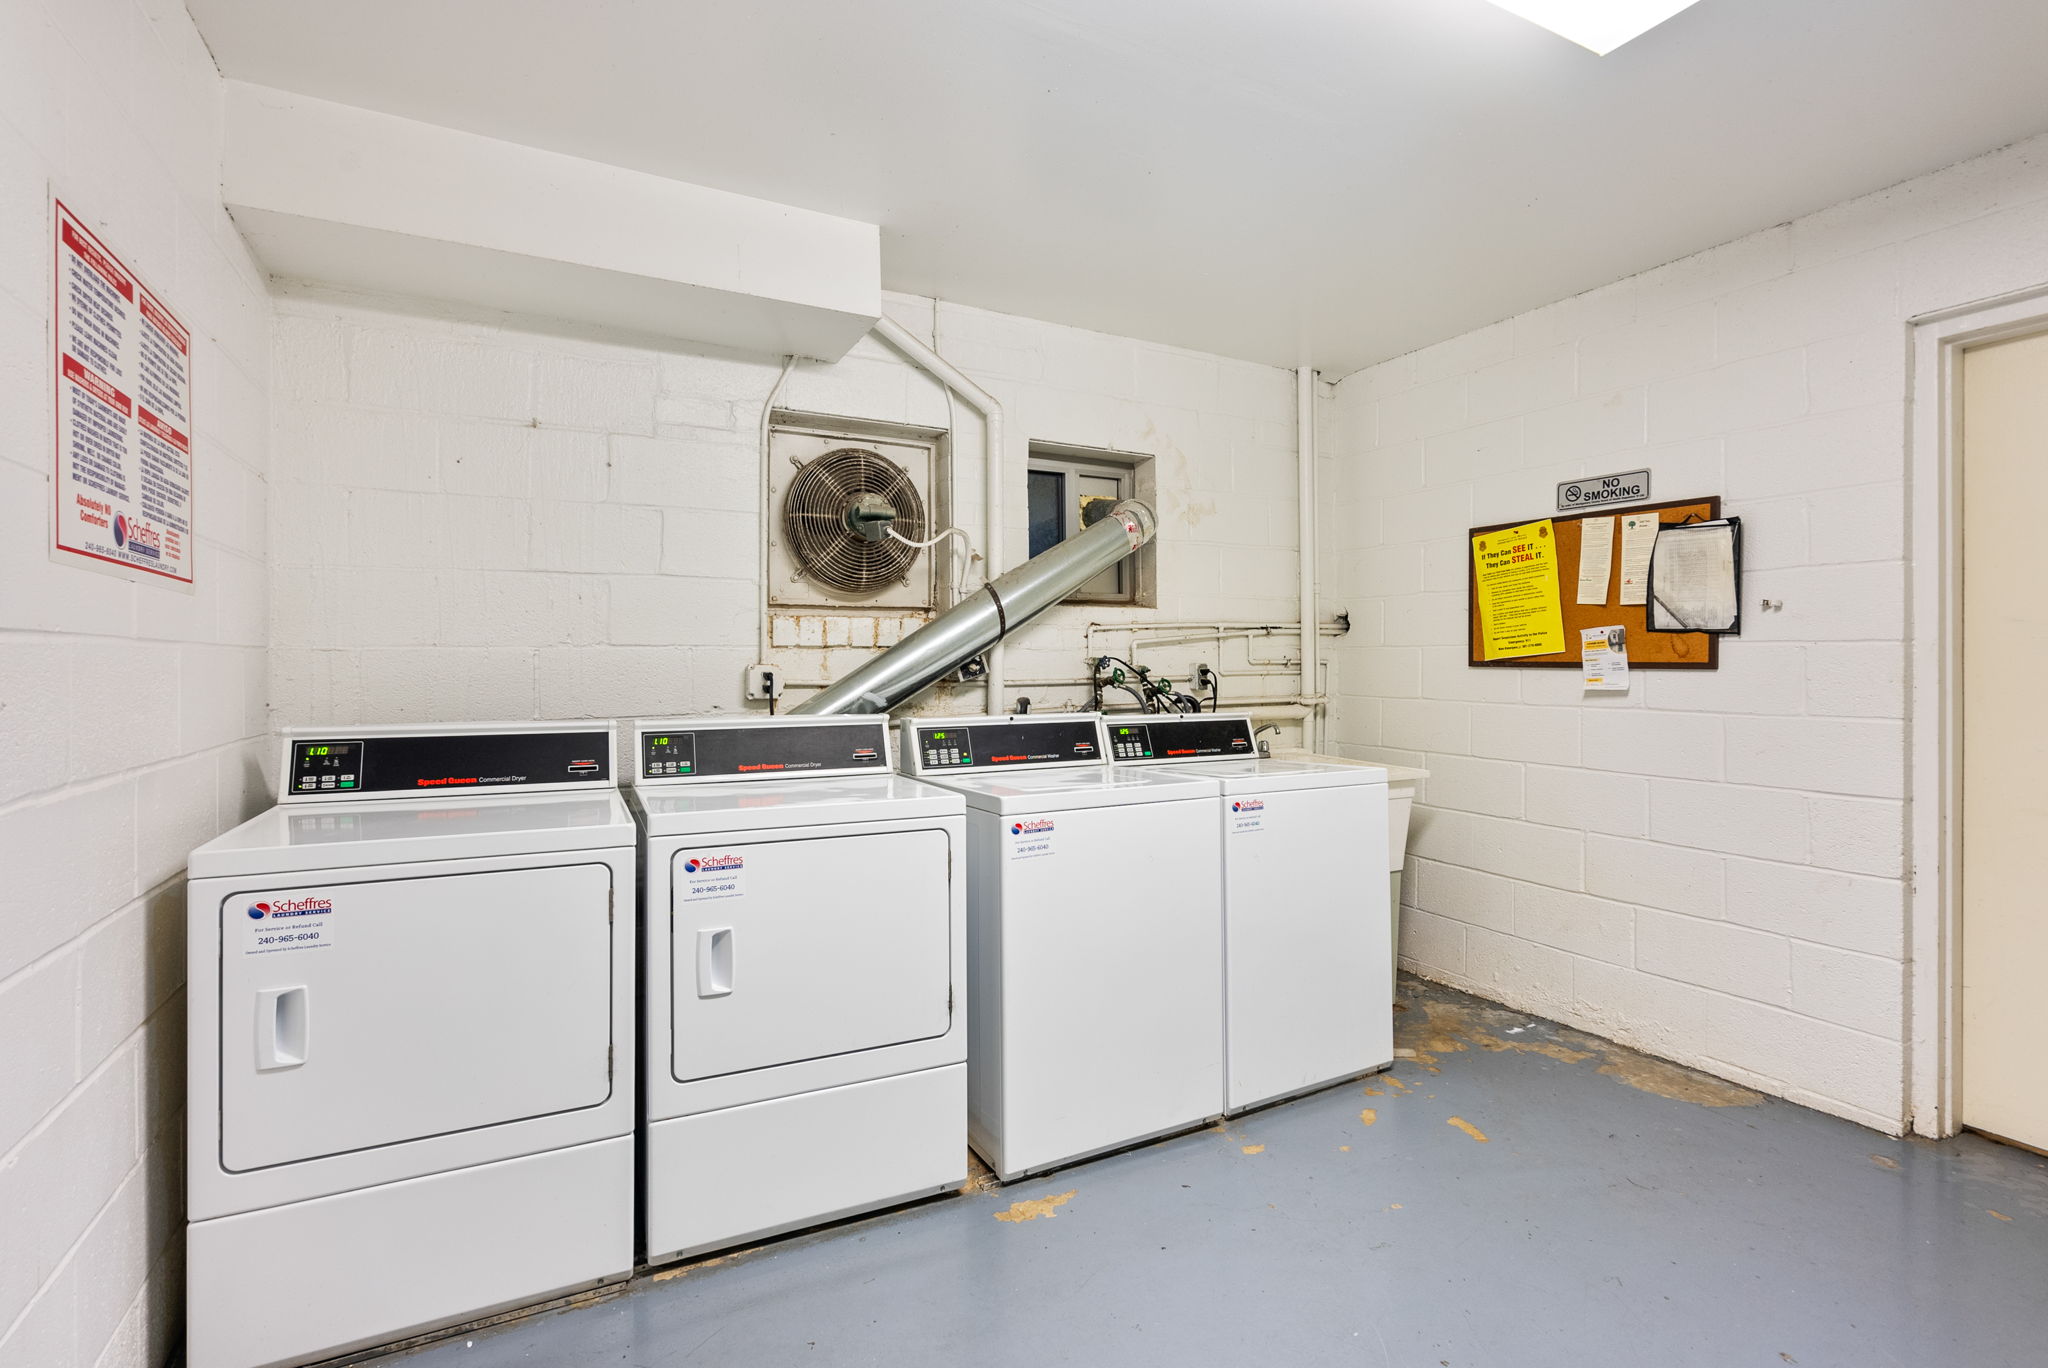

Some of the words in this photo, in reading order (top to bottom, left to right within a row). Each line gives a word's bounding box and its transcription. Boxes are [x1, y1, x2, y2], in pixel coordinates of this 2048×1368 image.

[83, 368, 114, 398] WARNING
[1602, 478, 1620, 489] NO
[1584, 485, 1640, 501] SMOKING
[76, 492, 103, 513] Absolutely
[104, 503, 111, 516] NO
[80, 508, 108, 529] Comforters
[127, 515, 160, 548] Scheffres
[1512, 544, 1526, 553] SEE
[1512, 553, 1534, 563] STEAL
[417, 778, 447, 786] Speed
[1024, 820, 1054, 830] Scheffres
[702, 855, 743, 867] Scheffres
[692, 884, 735, 894] 240-965-6040
[273, 897, 332, 912] Scheffres
[258, 932, 319, 944] 240-965-6040
